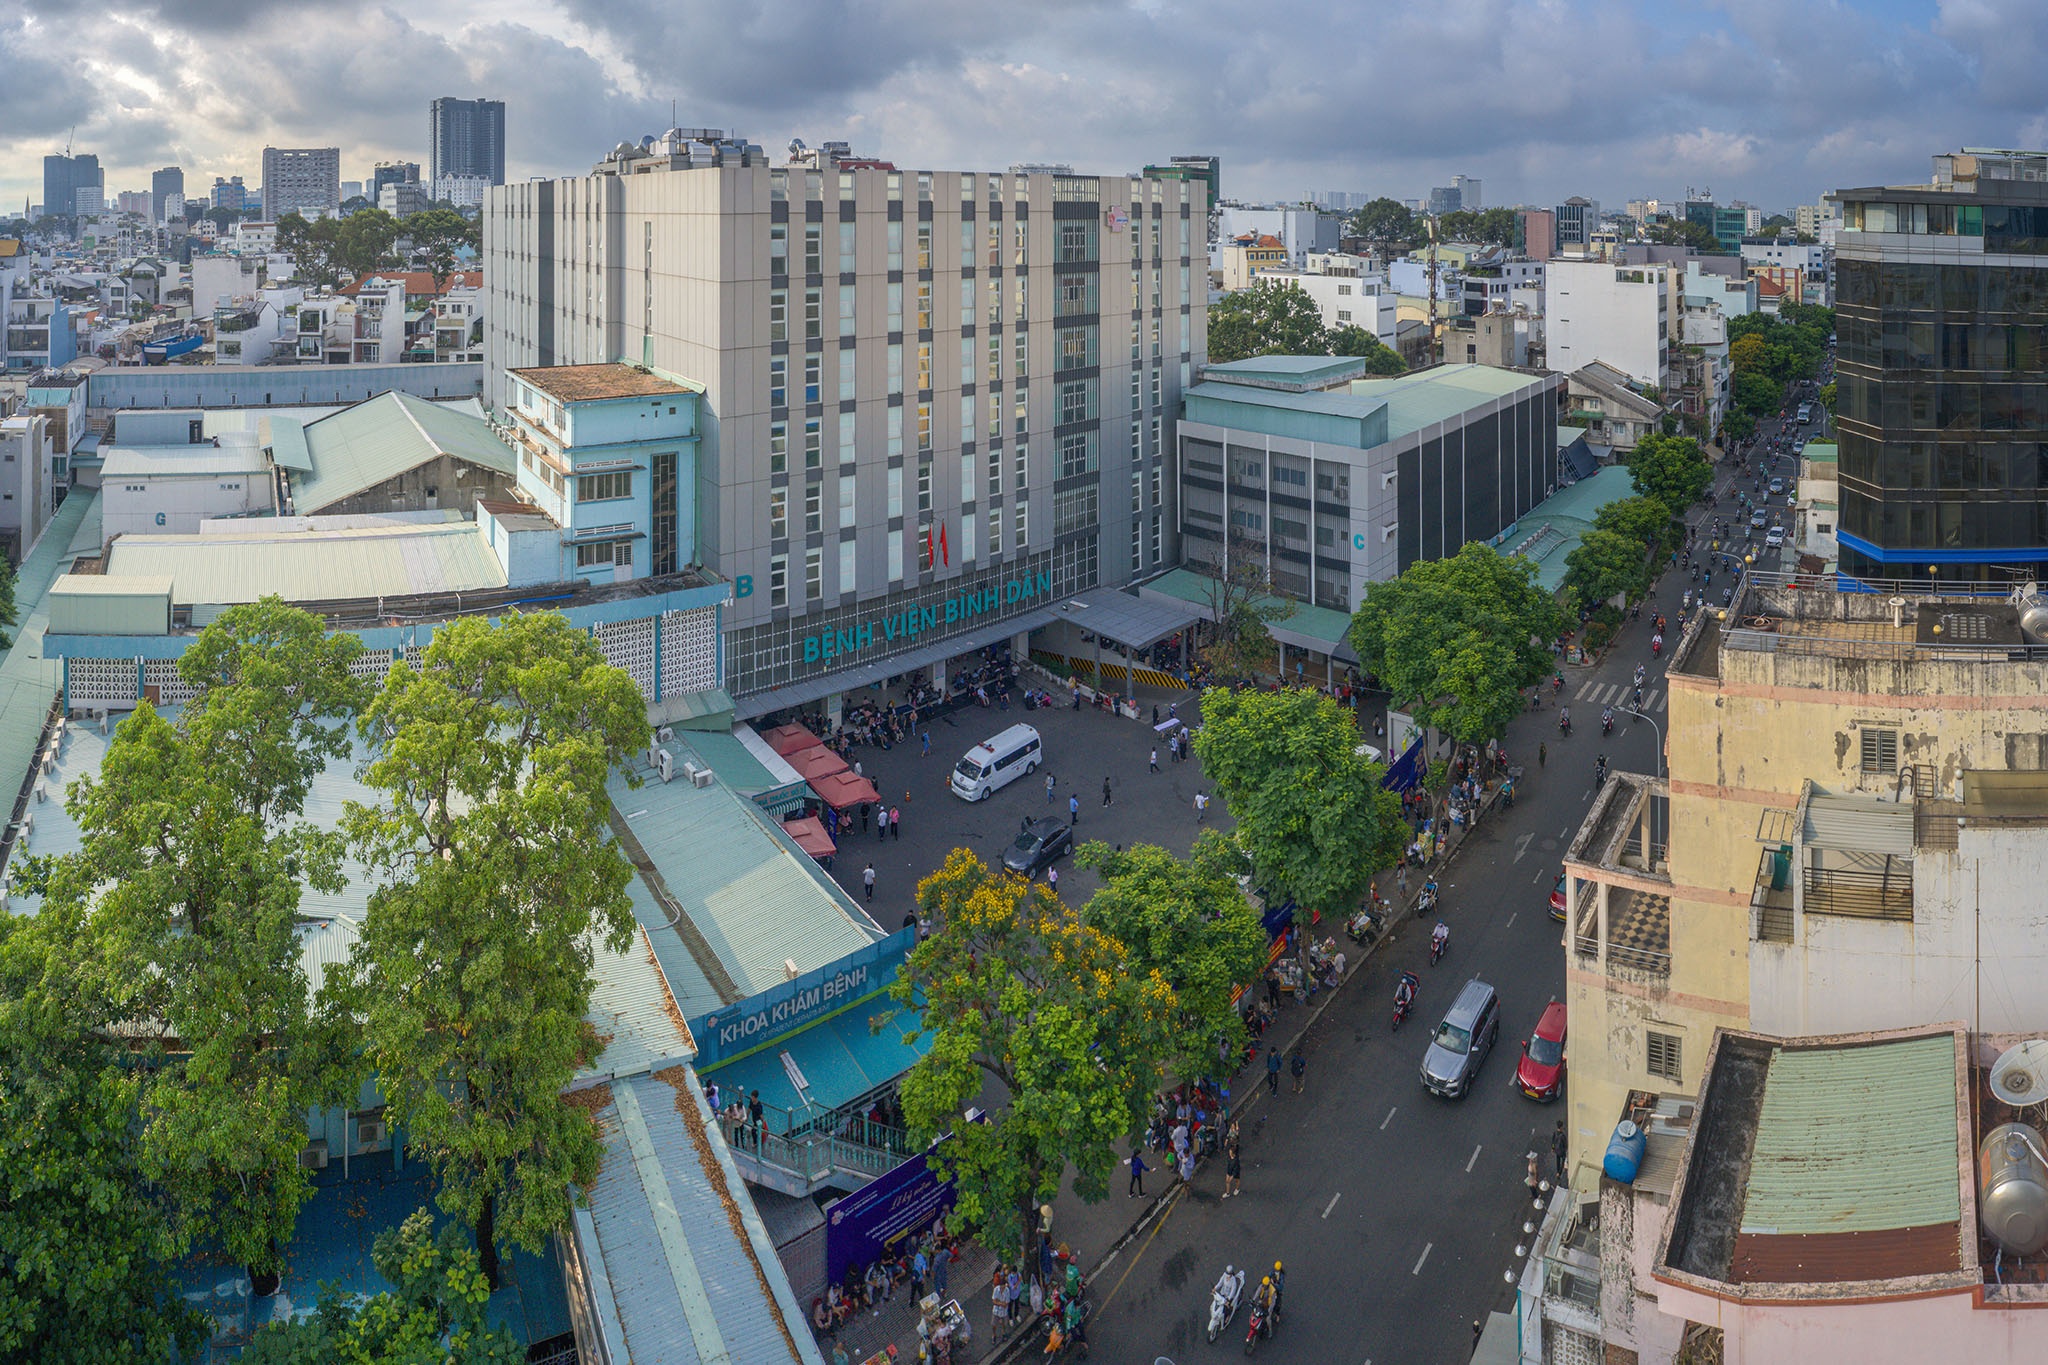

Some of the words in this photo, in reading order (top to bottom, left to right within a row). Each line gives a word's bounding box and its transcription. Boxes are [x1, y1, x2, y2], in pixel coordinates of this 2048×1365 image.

[155, 512, 166, 526] G
[1353, 533, 1365, 550] C
[736, 575, 753, 598] B
[803, 621, 873, 665] BỆNH
[882, 603, 937, 641] VIỆN
[945, 586, 999, 624] BÌNH
[1006, 569, 1052, 605] DÂN
[720, 1014, 769, 1046] KHOA
[772, 990, 820, 1024] KHÁM
[823, 965, 867, 1000] BỆNH
